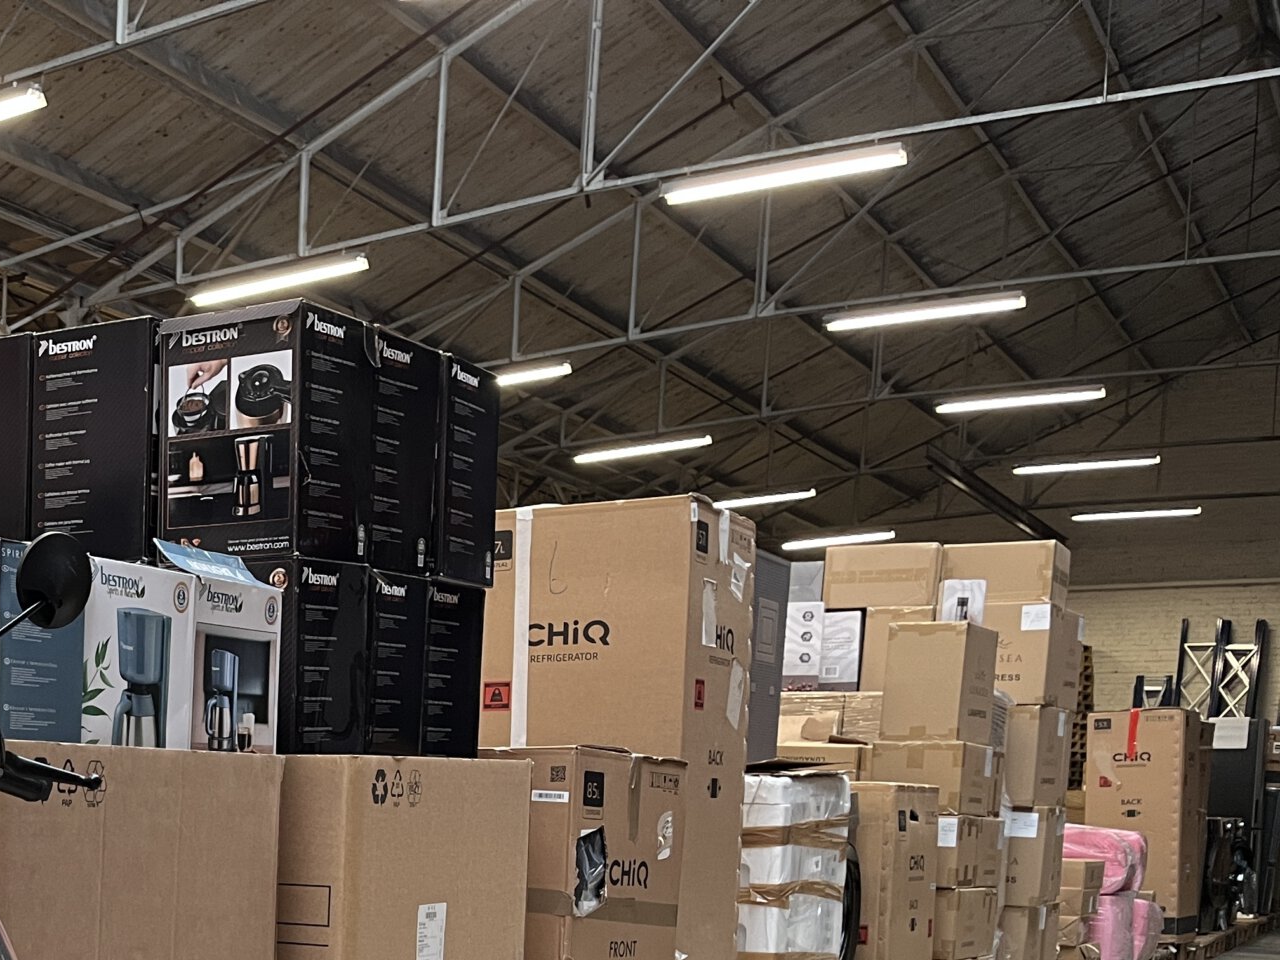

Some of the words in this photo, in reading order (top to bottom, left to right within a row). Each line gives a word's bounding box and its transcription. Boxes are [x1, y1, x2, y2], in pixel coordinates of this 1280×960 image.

[527, 619, 610, 647] CHiQ
[715, 624, 735, 656] HiQ
[530, 652, 599, 663] REFRIGERATOR
[708, 750, 724, 766] BACK
[609, 859, 649, 889] CHiQ
[609, 940, 638, 958] FRONT
